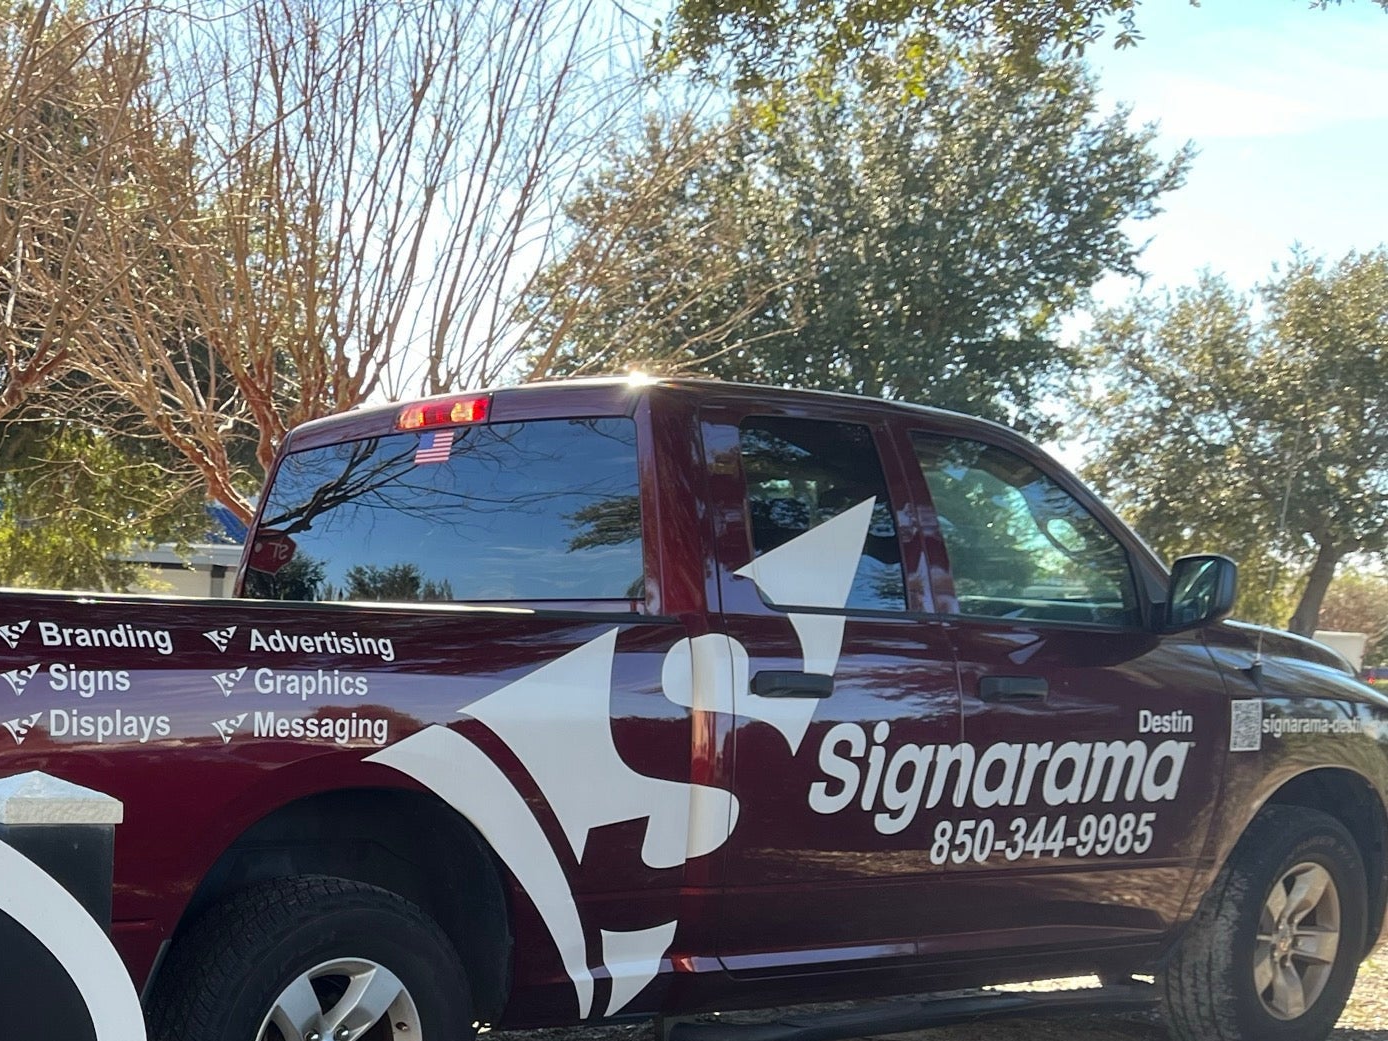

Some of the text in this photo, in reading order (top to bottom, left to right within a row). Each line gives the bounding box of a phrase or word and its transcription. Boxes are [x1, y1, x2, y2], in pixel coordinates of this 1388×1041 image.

[39, 622, 173, 655] Branding
[249, 628, 395, 661] Advertising
[49, 663, 131, 698] Signs
[254, 667, 369, 700] Graphics
[49, 709, 171, 743] Displays
[253, 711, 388, 744] Messaging
[1138, 709, 1193, 734] Destin
[808, 720, 1192, 835] Signarama
[929, 812, 1156, 865] 850-344-9985
